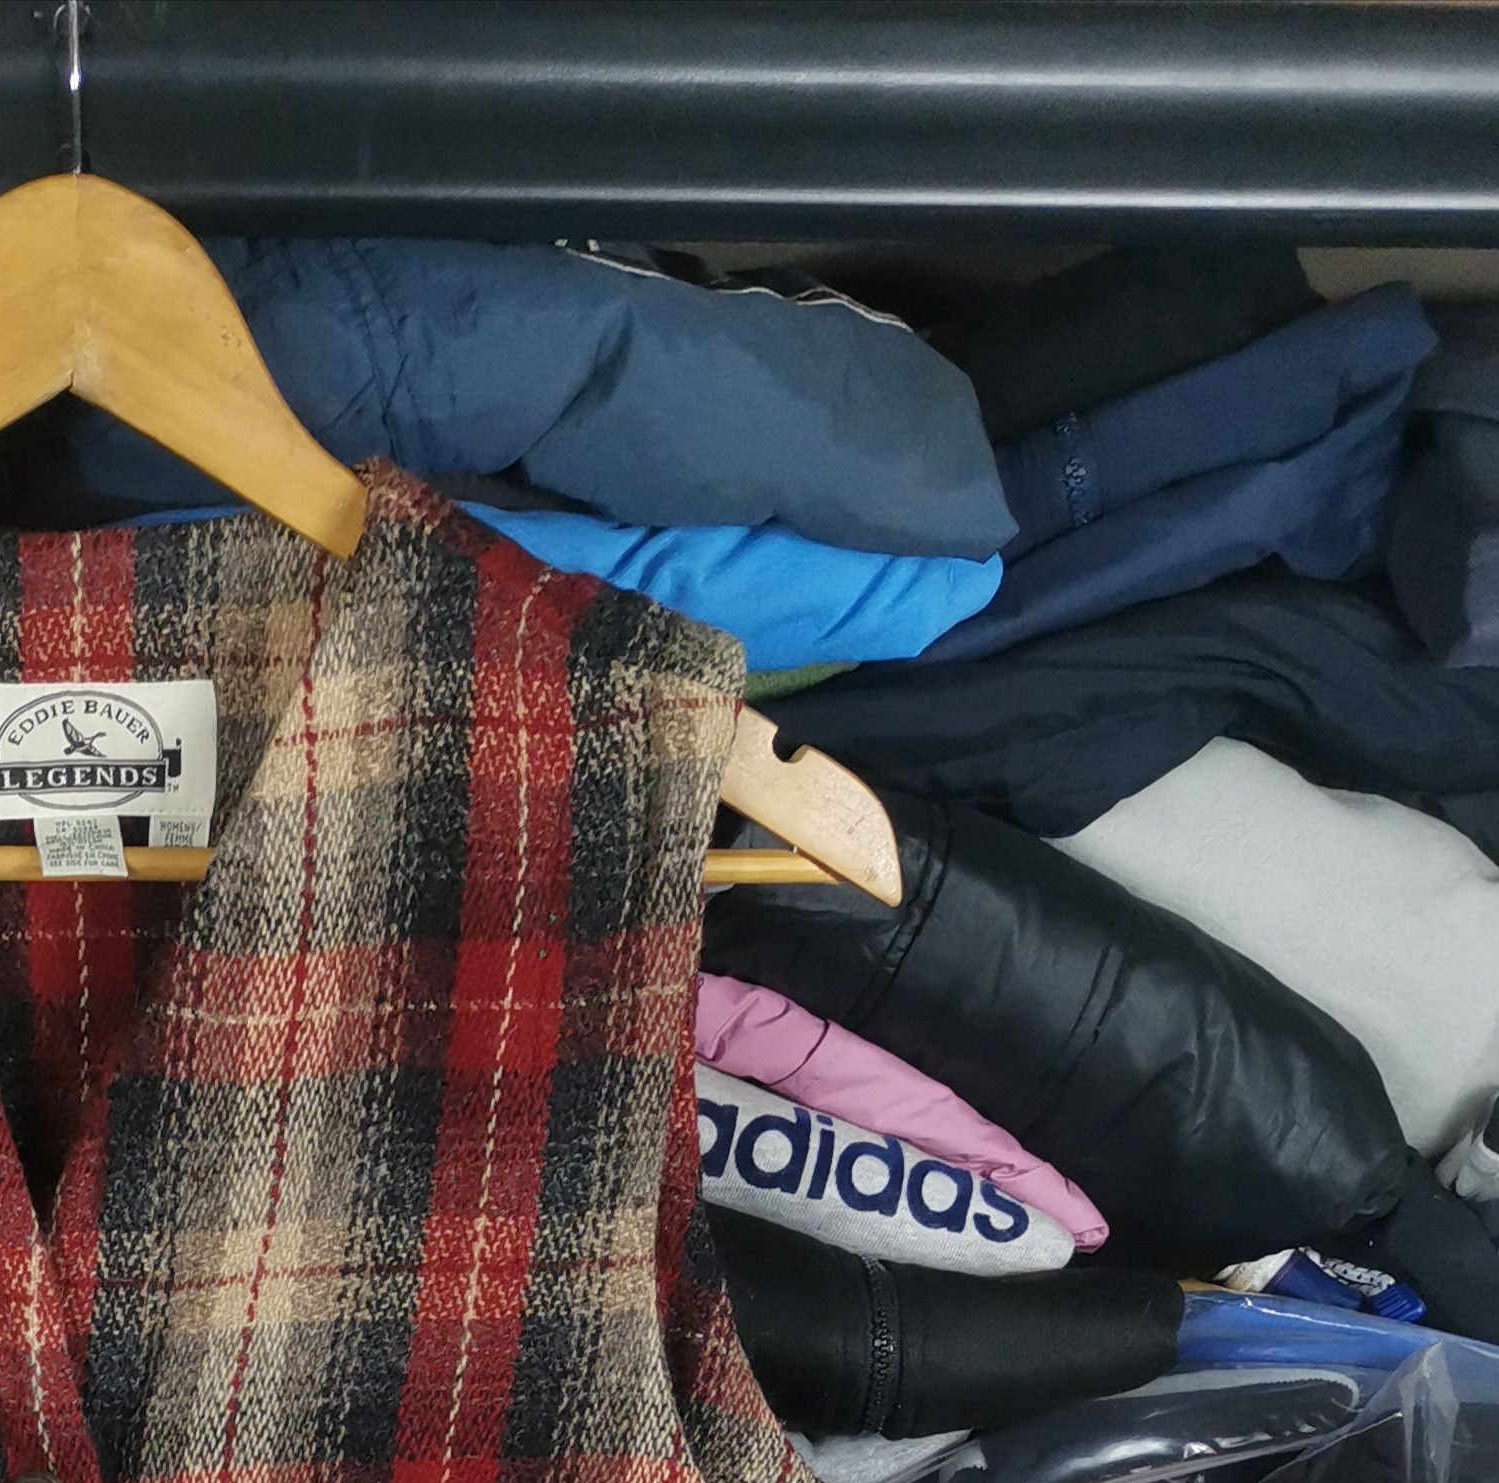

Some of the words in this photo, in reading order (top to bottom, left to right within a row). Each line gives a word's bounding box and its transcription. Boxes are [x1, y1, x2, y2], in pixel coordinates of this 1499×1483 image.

[7, 699, 75, 746] EDDIE
[83, 699, 150, 745] BAUER
[1, 766, 158, 789] LEGENDS
[699, 1097, 1030, 1243] adidas
